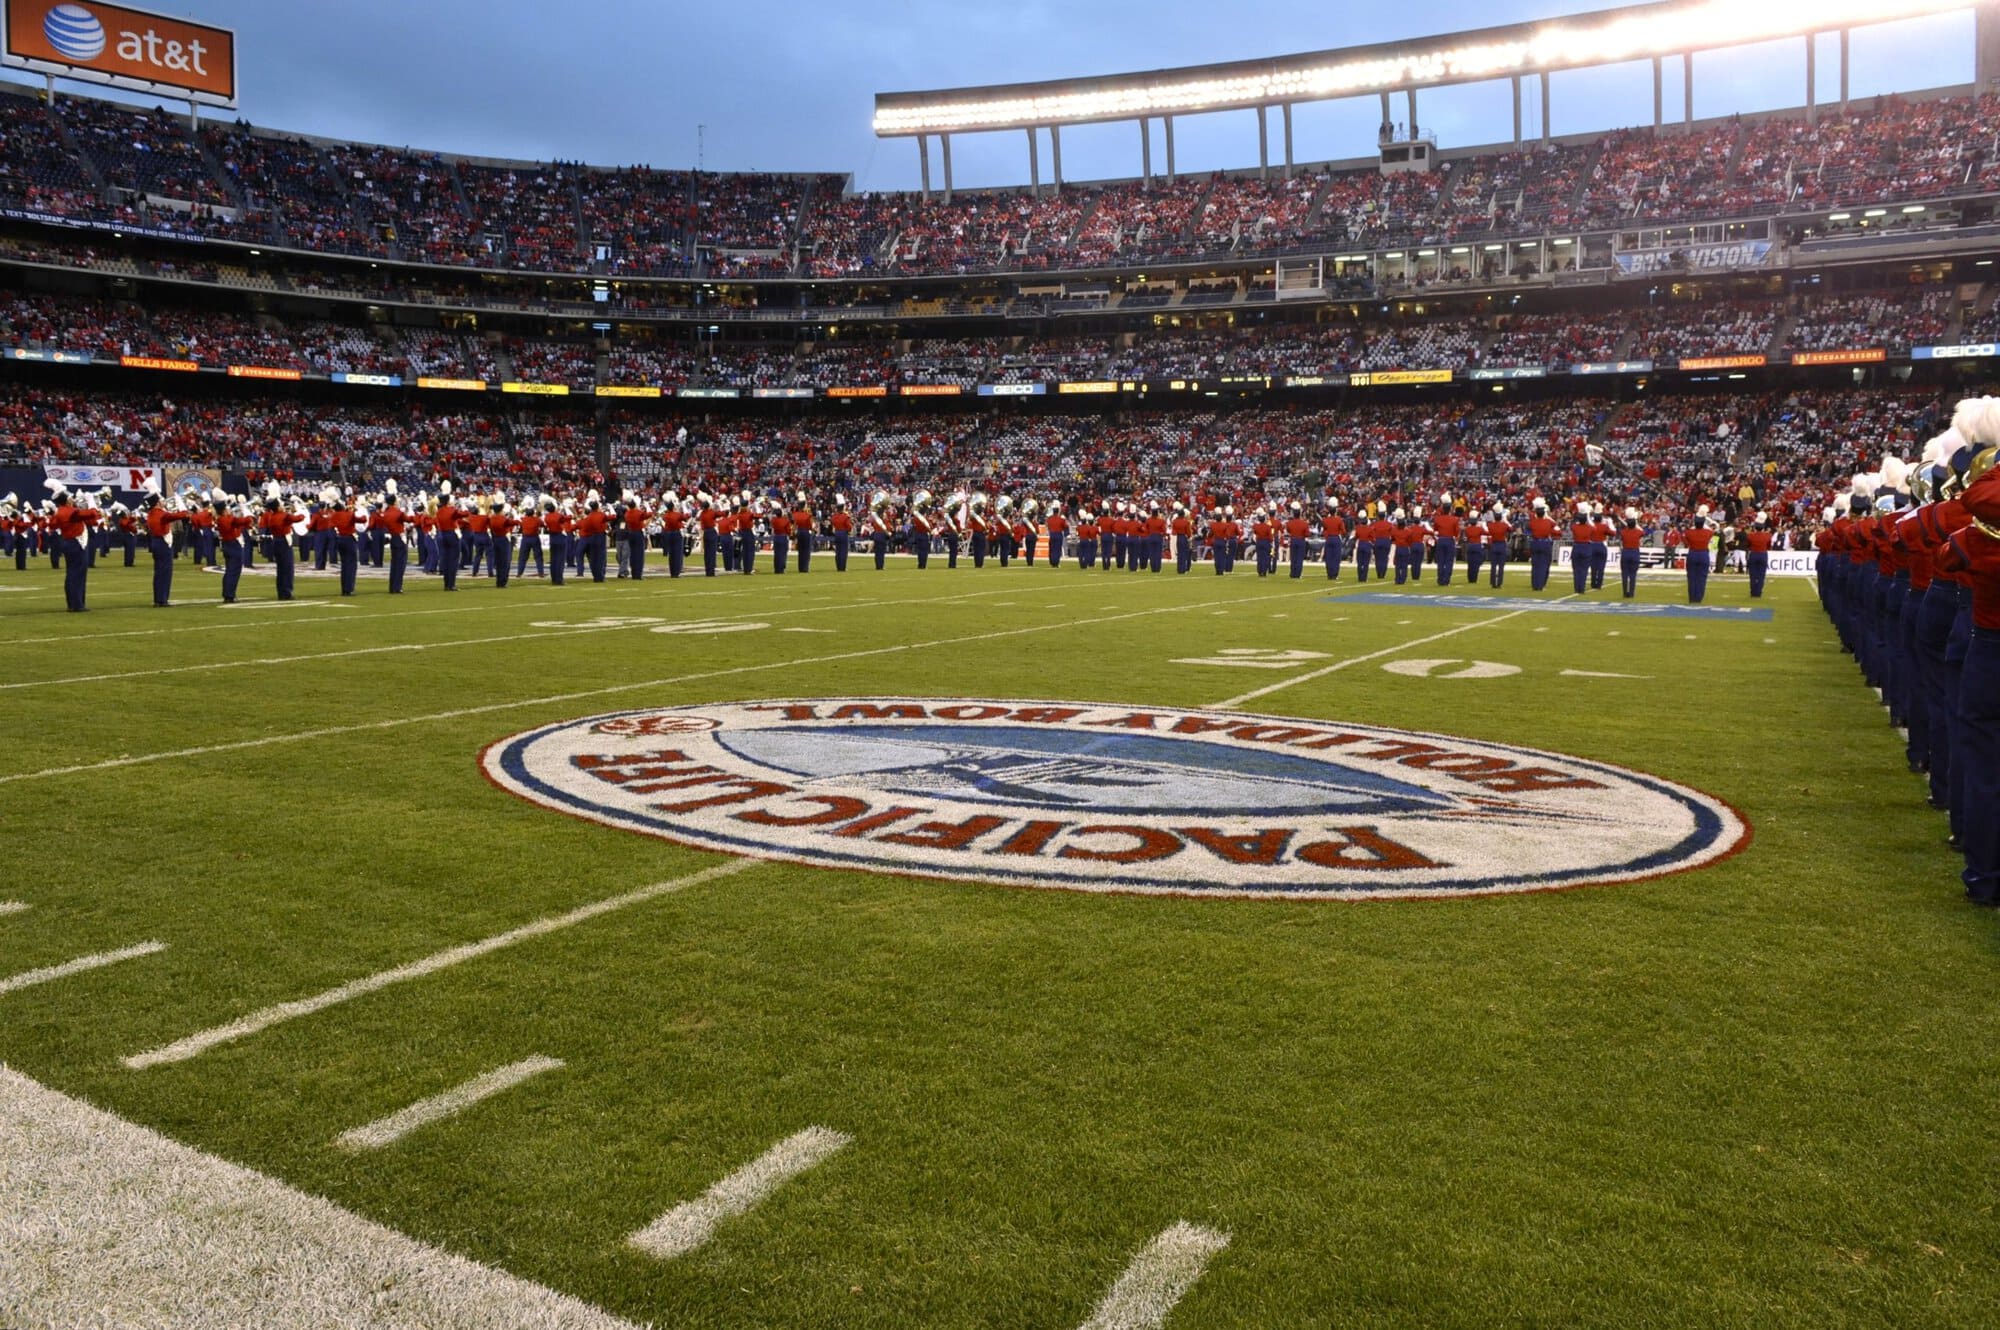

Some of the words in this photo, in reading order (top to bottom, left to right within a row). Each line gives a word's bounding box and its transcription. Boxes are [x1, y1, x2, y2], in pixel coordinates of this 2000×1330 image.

[117, 29, 207, 76] at&t
[111, 224, 143, 234] LOCATION
[1931, 344, 1995, 358] GEICO
[123, 357, 160, 368] WELLS
[162, 360, 197, 371] FARGO
[1683, 359, 1724, 369] WELLS
[1725, 356, 1765, 367] FARGO
[346, 374, 390, 385] GEICO
[829, 387, 857, 396] WELLS
[859, 387, 885, 396] FARGO
[993, 384, 1033, 394] GEICO
[130, 469, 153, 489] N
[1168, 648, 1522, 679] 20
[750, 703, 1092, 723] BOWL
[1080, 712, 1610, 793] HOLIDAY
[570, 750, 803, 814] LIFE
[732, 795, 1455, 870] PACIFIC
